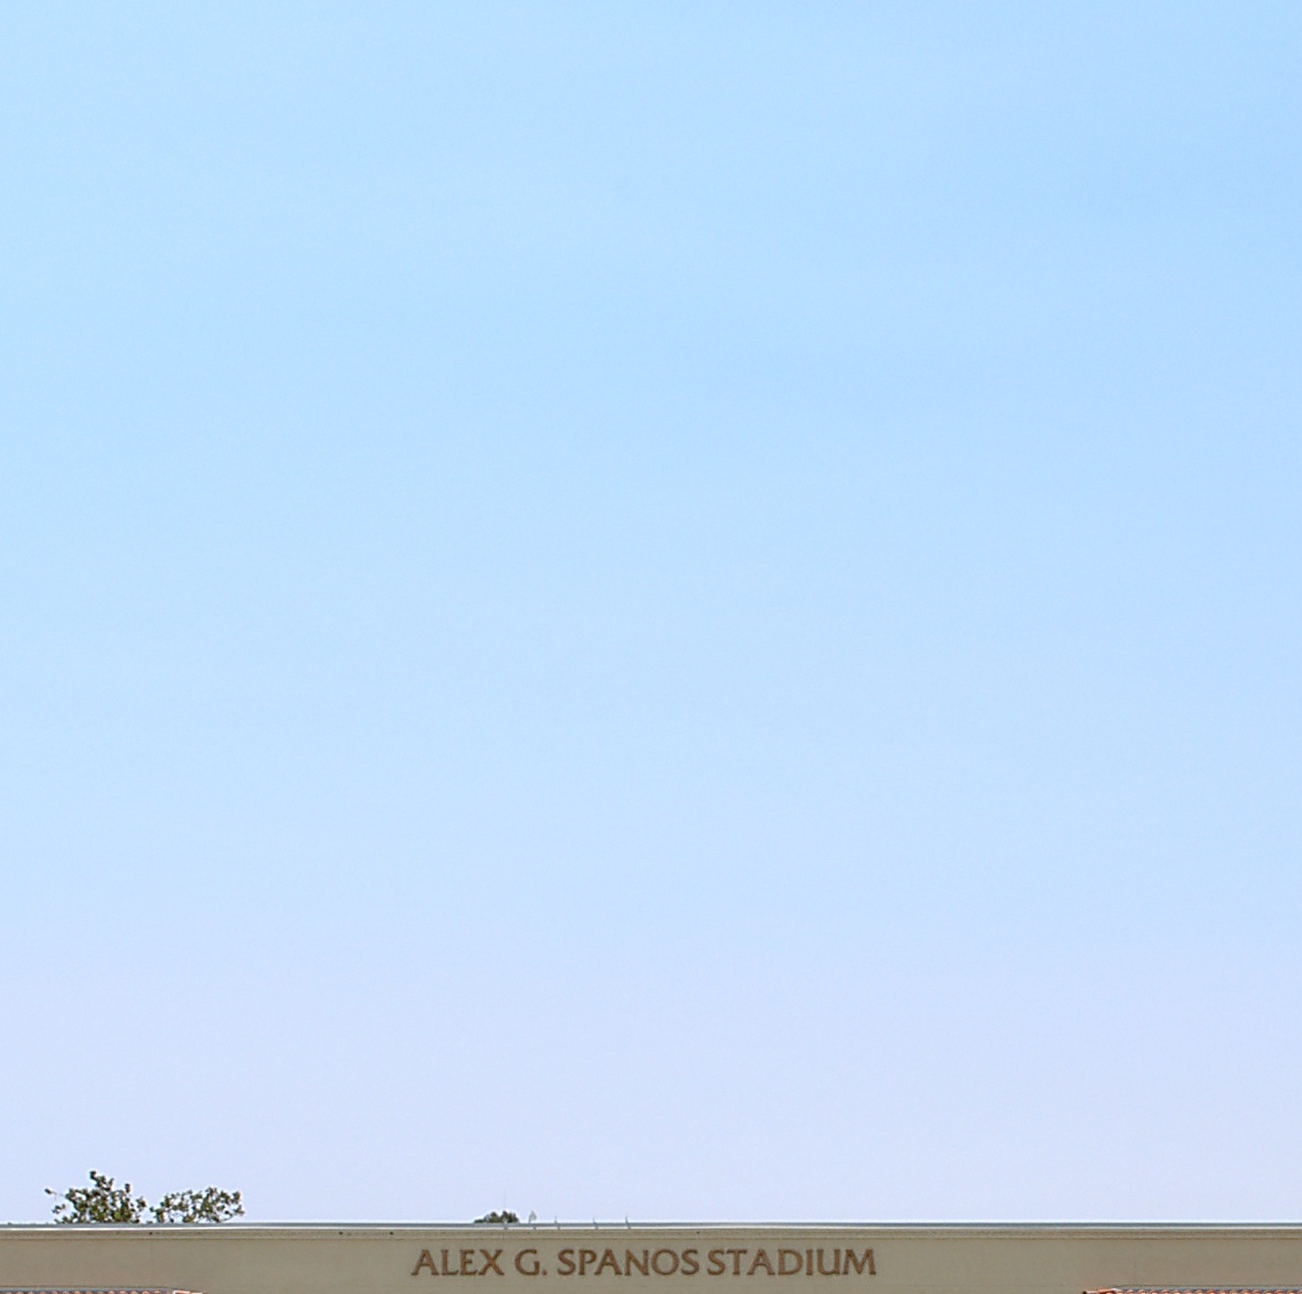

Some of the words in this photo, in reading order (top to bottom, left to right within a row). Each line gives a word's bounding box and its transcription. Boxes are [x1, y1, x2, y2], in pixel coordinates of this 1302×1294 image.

[410, 1248, 505, 1277] ALEX
[514, 1248, 548, 1277] G.
[556, 1248, 700, 1277] SPANOS
[706, 1248, 877, 1277] STADIUM
